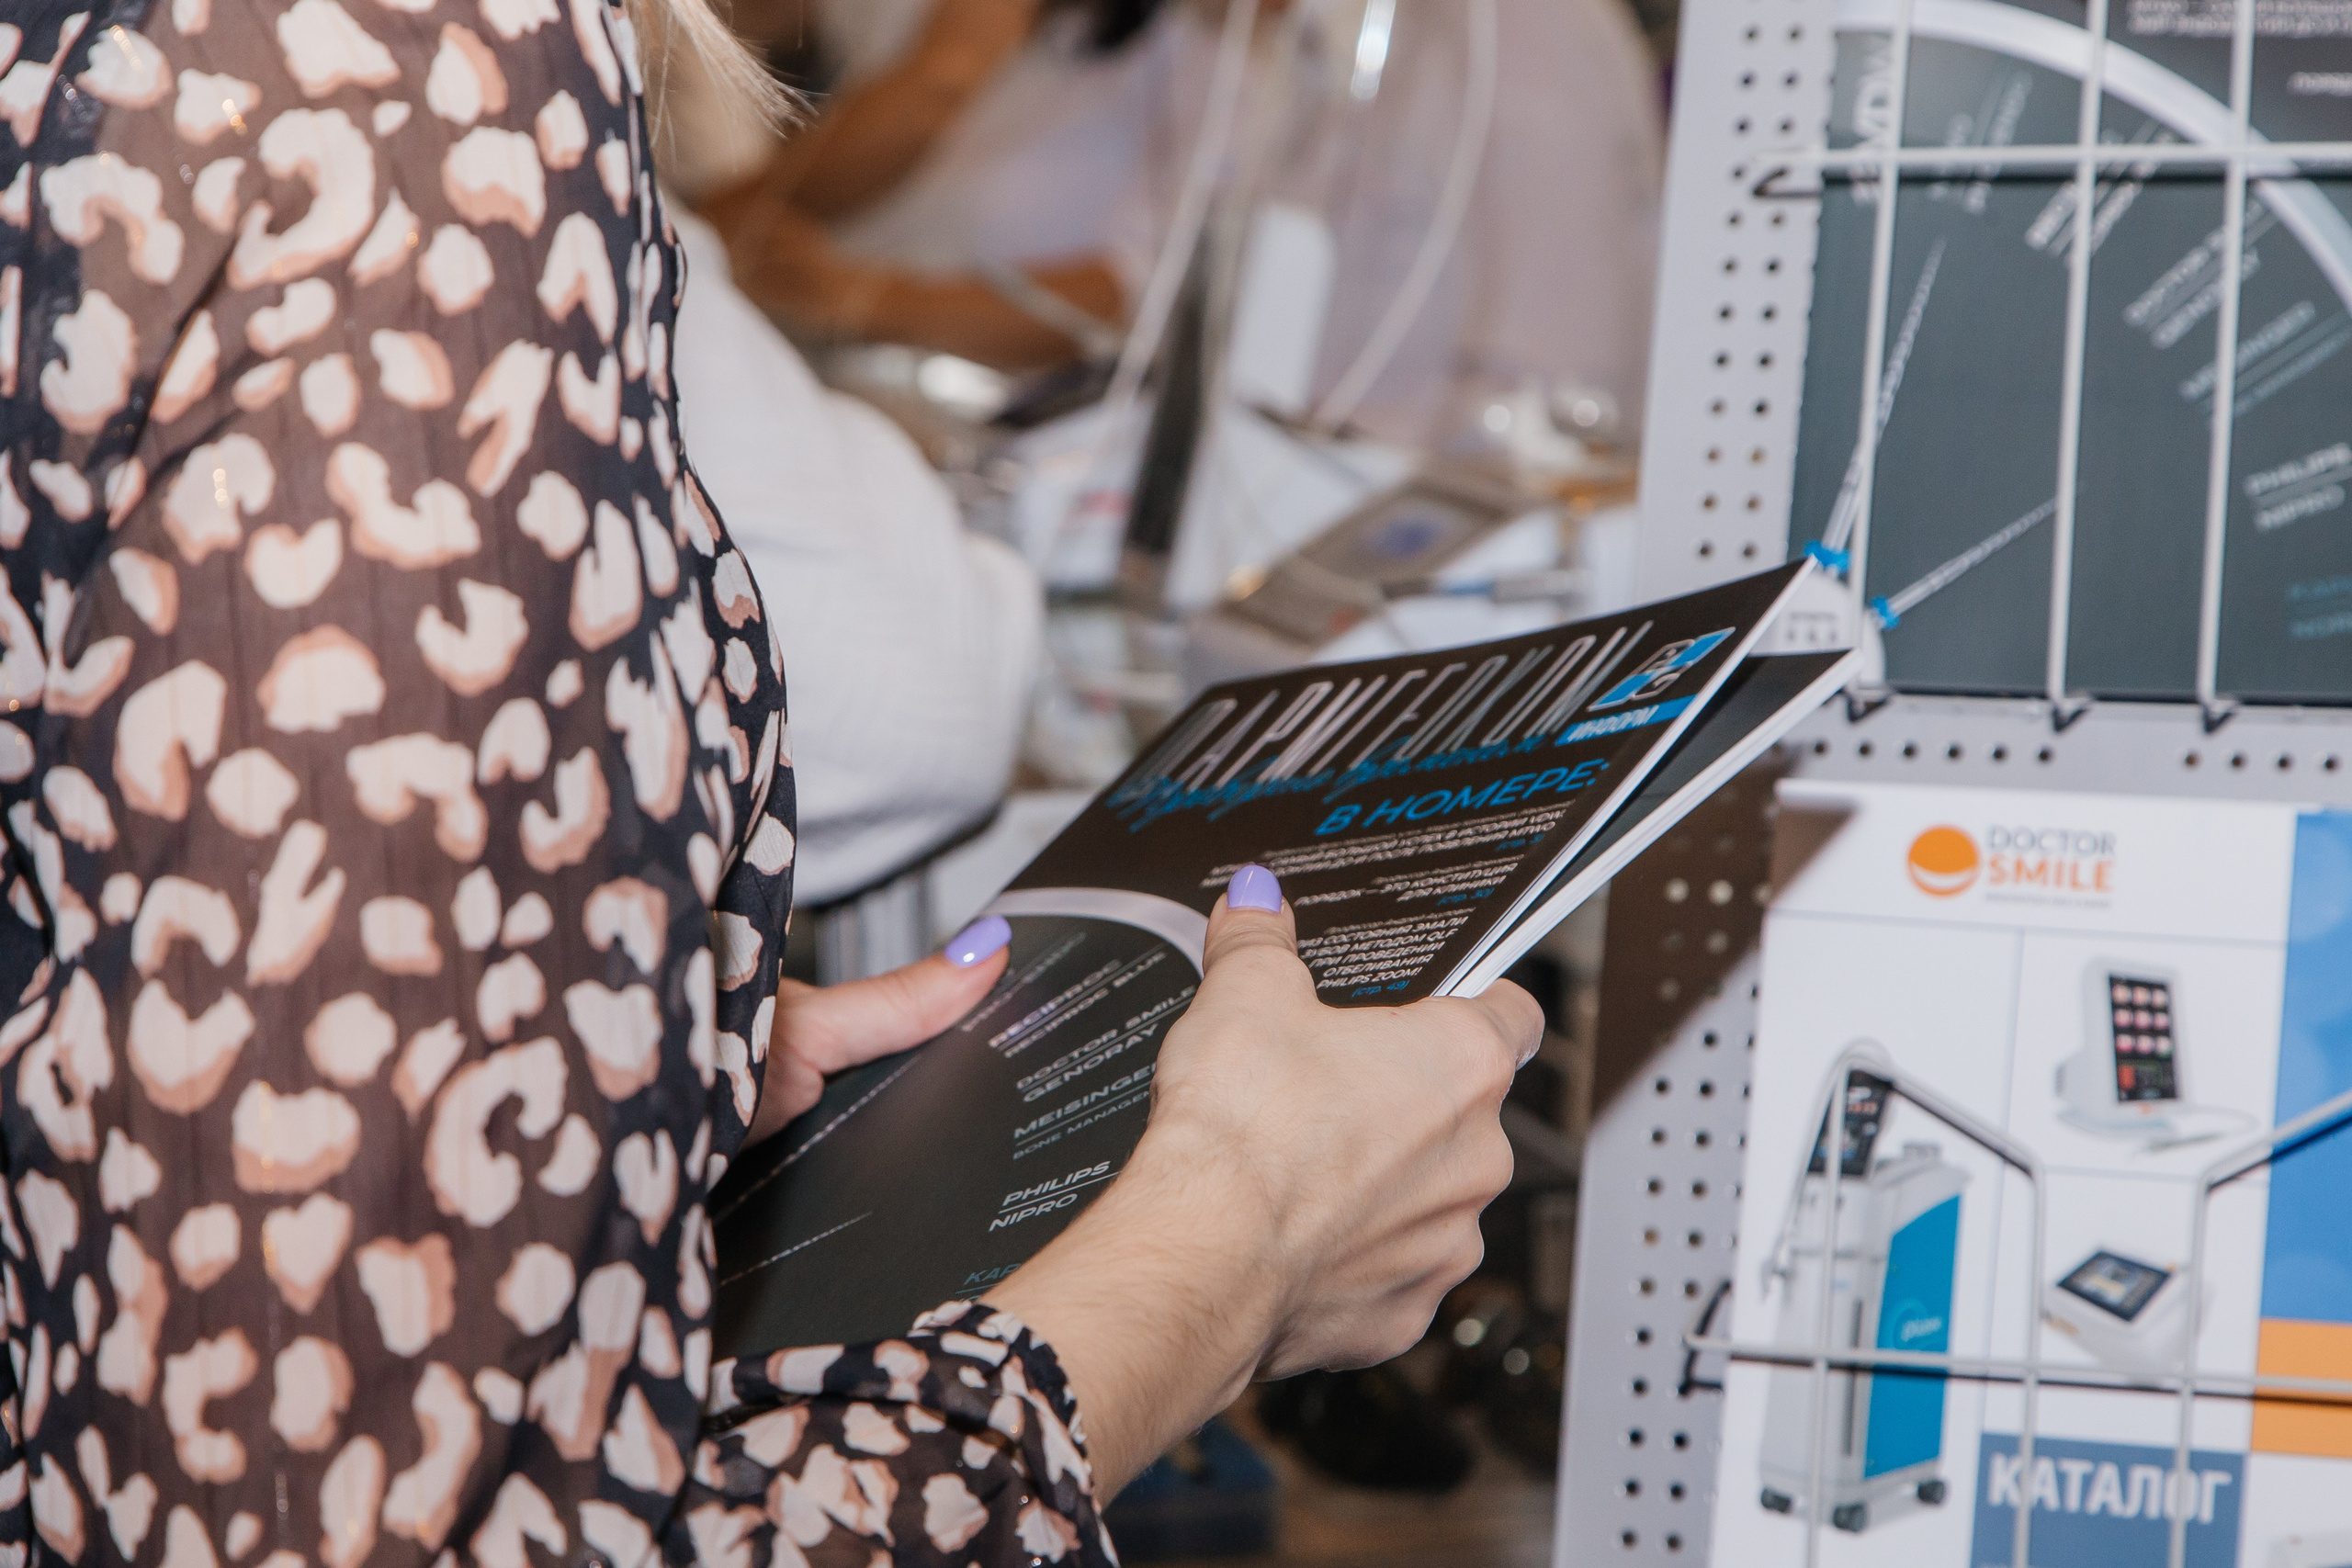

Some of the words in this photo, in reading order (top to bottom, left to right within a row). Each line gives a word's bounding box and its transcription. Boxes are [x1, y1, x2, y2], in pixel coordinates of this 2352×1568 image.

[1315, 804, 1362, 835] В
[1363, 759, 1610, 827] НОМЕРЕ:
[1988, 824, 2116, 856] DOCTOR
[1988, 853, 2114, 893] SMILE
[1300, 943, 1351, 960] ЗУБОВ
[1350, 933, 1427, 952] МЕТОДОМ
[1426, 928, 1459, 942] QLF
[1323, 924, 1413, 945] СОСТОЯНИЯ
[1412, 916, 1469, 932] ЭМАЛИ
[1113, 952, 1168, 988] BLUE
[1308, 955, 1343, 968] ПРИ
[1341, 941, 1446, 964] ПРОВЕДЕНИИ
[1323, 953, 1434, 977] ОТБЕЛИВАНИЯ
[1317, 974, 1374, 989] PHILIPS
[1372, 966, 1423, 982] ZOOM!
[988, 958, 1122, 1048] RECIPROC
[1016, 1029, 1118, 1089] DOCTOR
[1125, 986, 1194, 1030] SMILE
[1023, 1023, 1158, 1102] GENORAY
[1012, 1132, 1062, 1159] BONE
[1001, 1161, 1111, 1206] PHILIPS
[989, 1193, 1078, 1232] NIPRO
[1986, 1451, 2233, 1525] КАТАЛОГ
